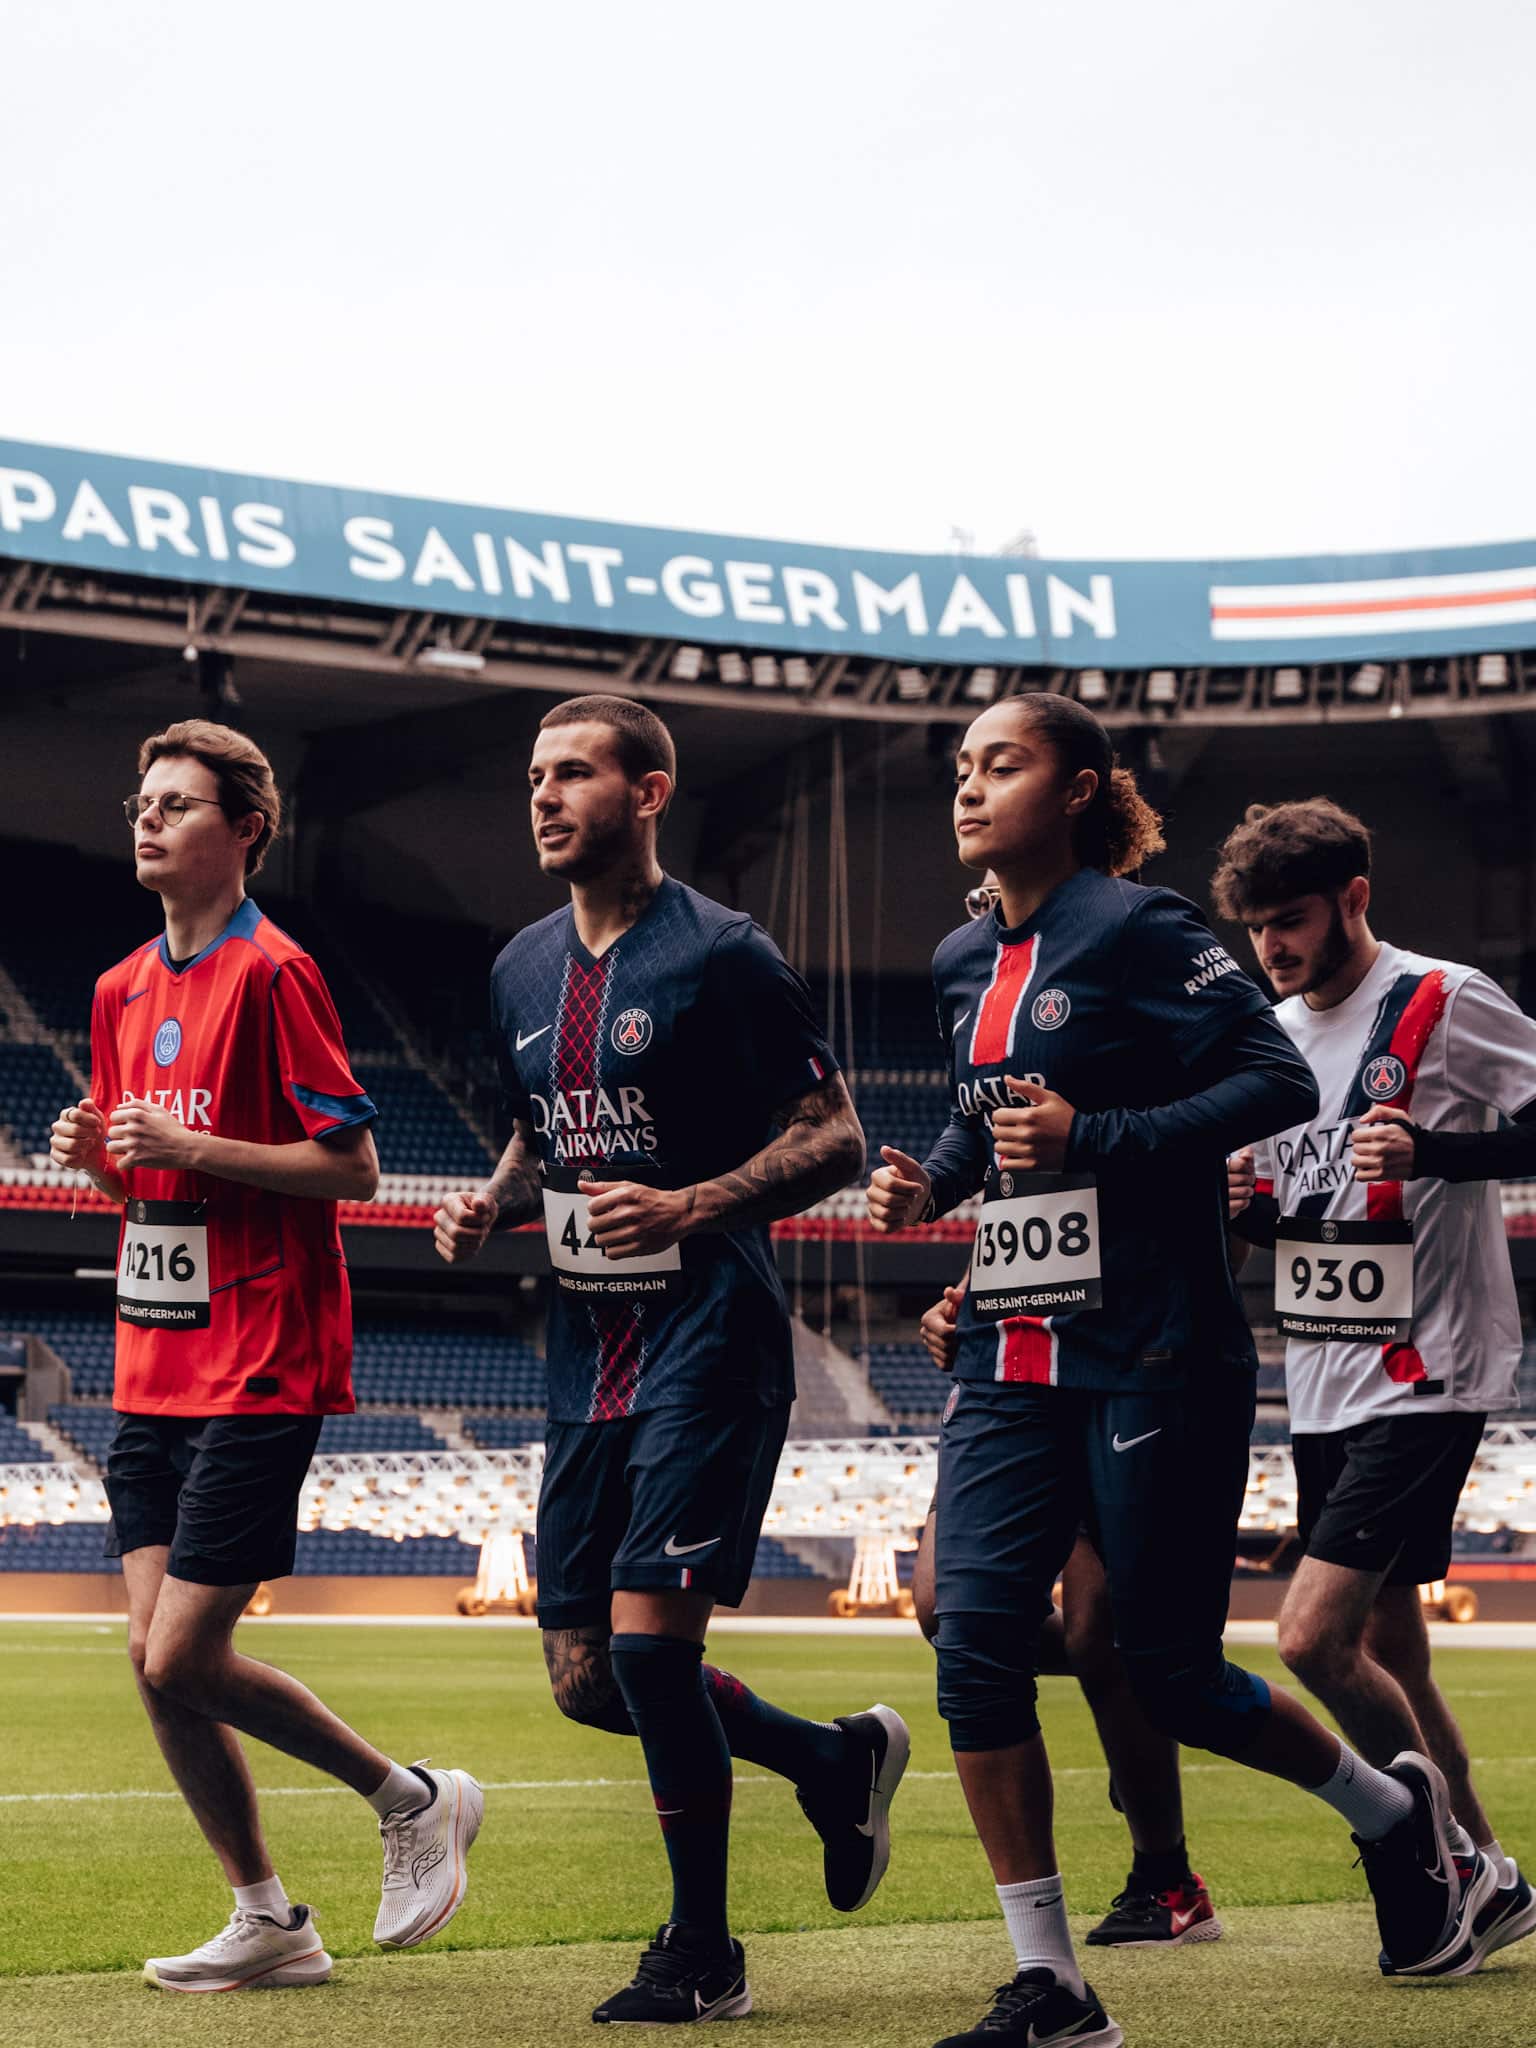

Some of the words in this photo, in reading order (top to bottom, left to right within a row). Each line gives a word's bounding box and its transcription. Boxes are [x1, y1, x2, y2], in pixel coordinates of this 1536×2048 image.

[0, 466, 296, 568] PARIS
[344, 517, 1117, 640] SAINT-GERMAIN
[620, 1010, 647, 1022] PARIS
[529, 1086, 654, 1140] QATAR
[554, 1125, 658, 1159] AIRWAYS
[1277, 1122, 1358, 1177] QATA
[1299, 1164, 1358, 1192] AIRW
[976, 1211, 1091, 1268] 13908
[576, 1280, 667, 1293] SAINT-GERMAIN
[1291, 1255, 1385, 1303] 930
[976, 1298, 999, 1312] PARIS
[1000, 1288, 1087, 1308] SAINT-GERMAIN
[1282, 1319, 1305, 1332] PARIS
[1305, 1321, 1397, 1336] SAINT-GERMAIN
